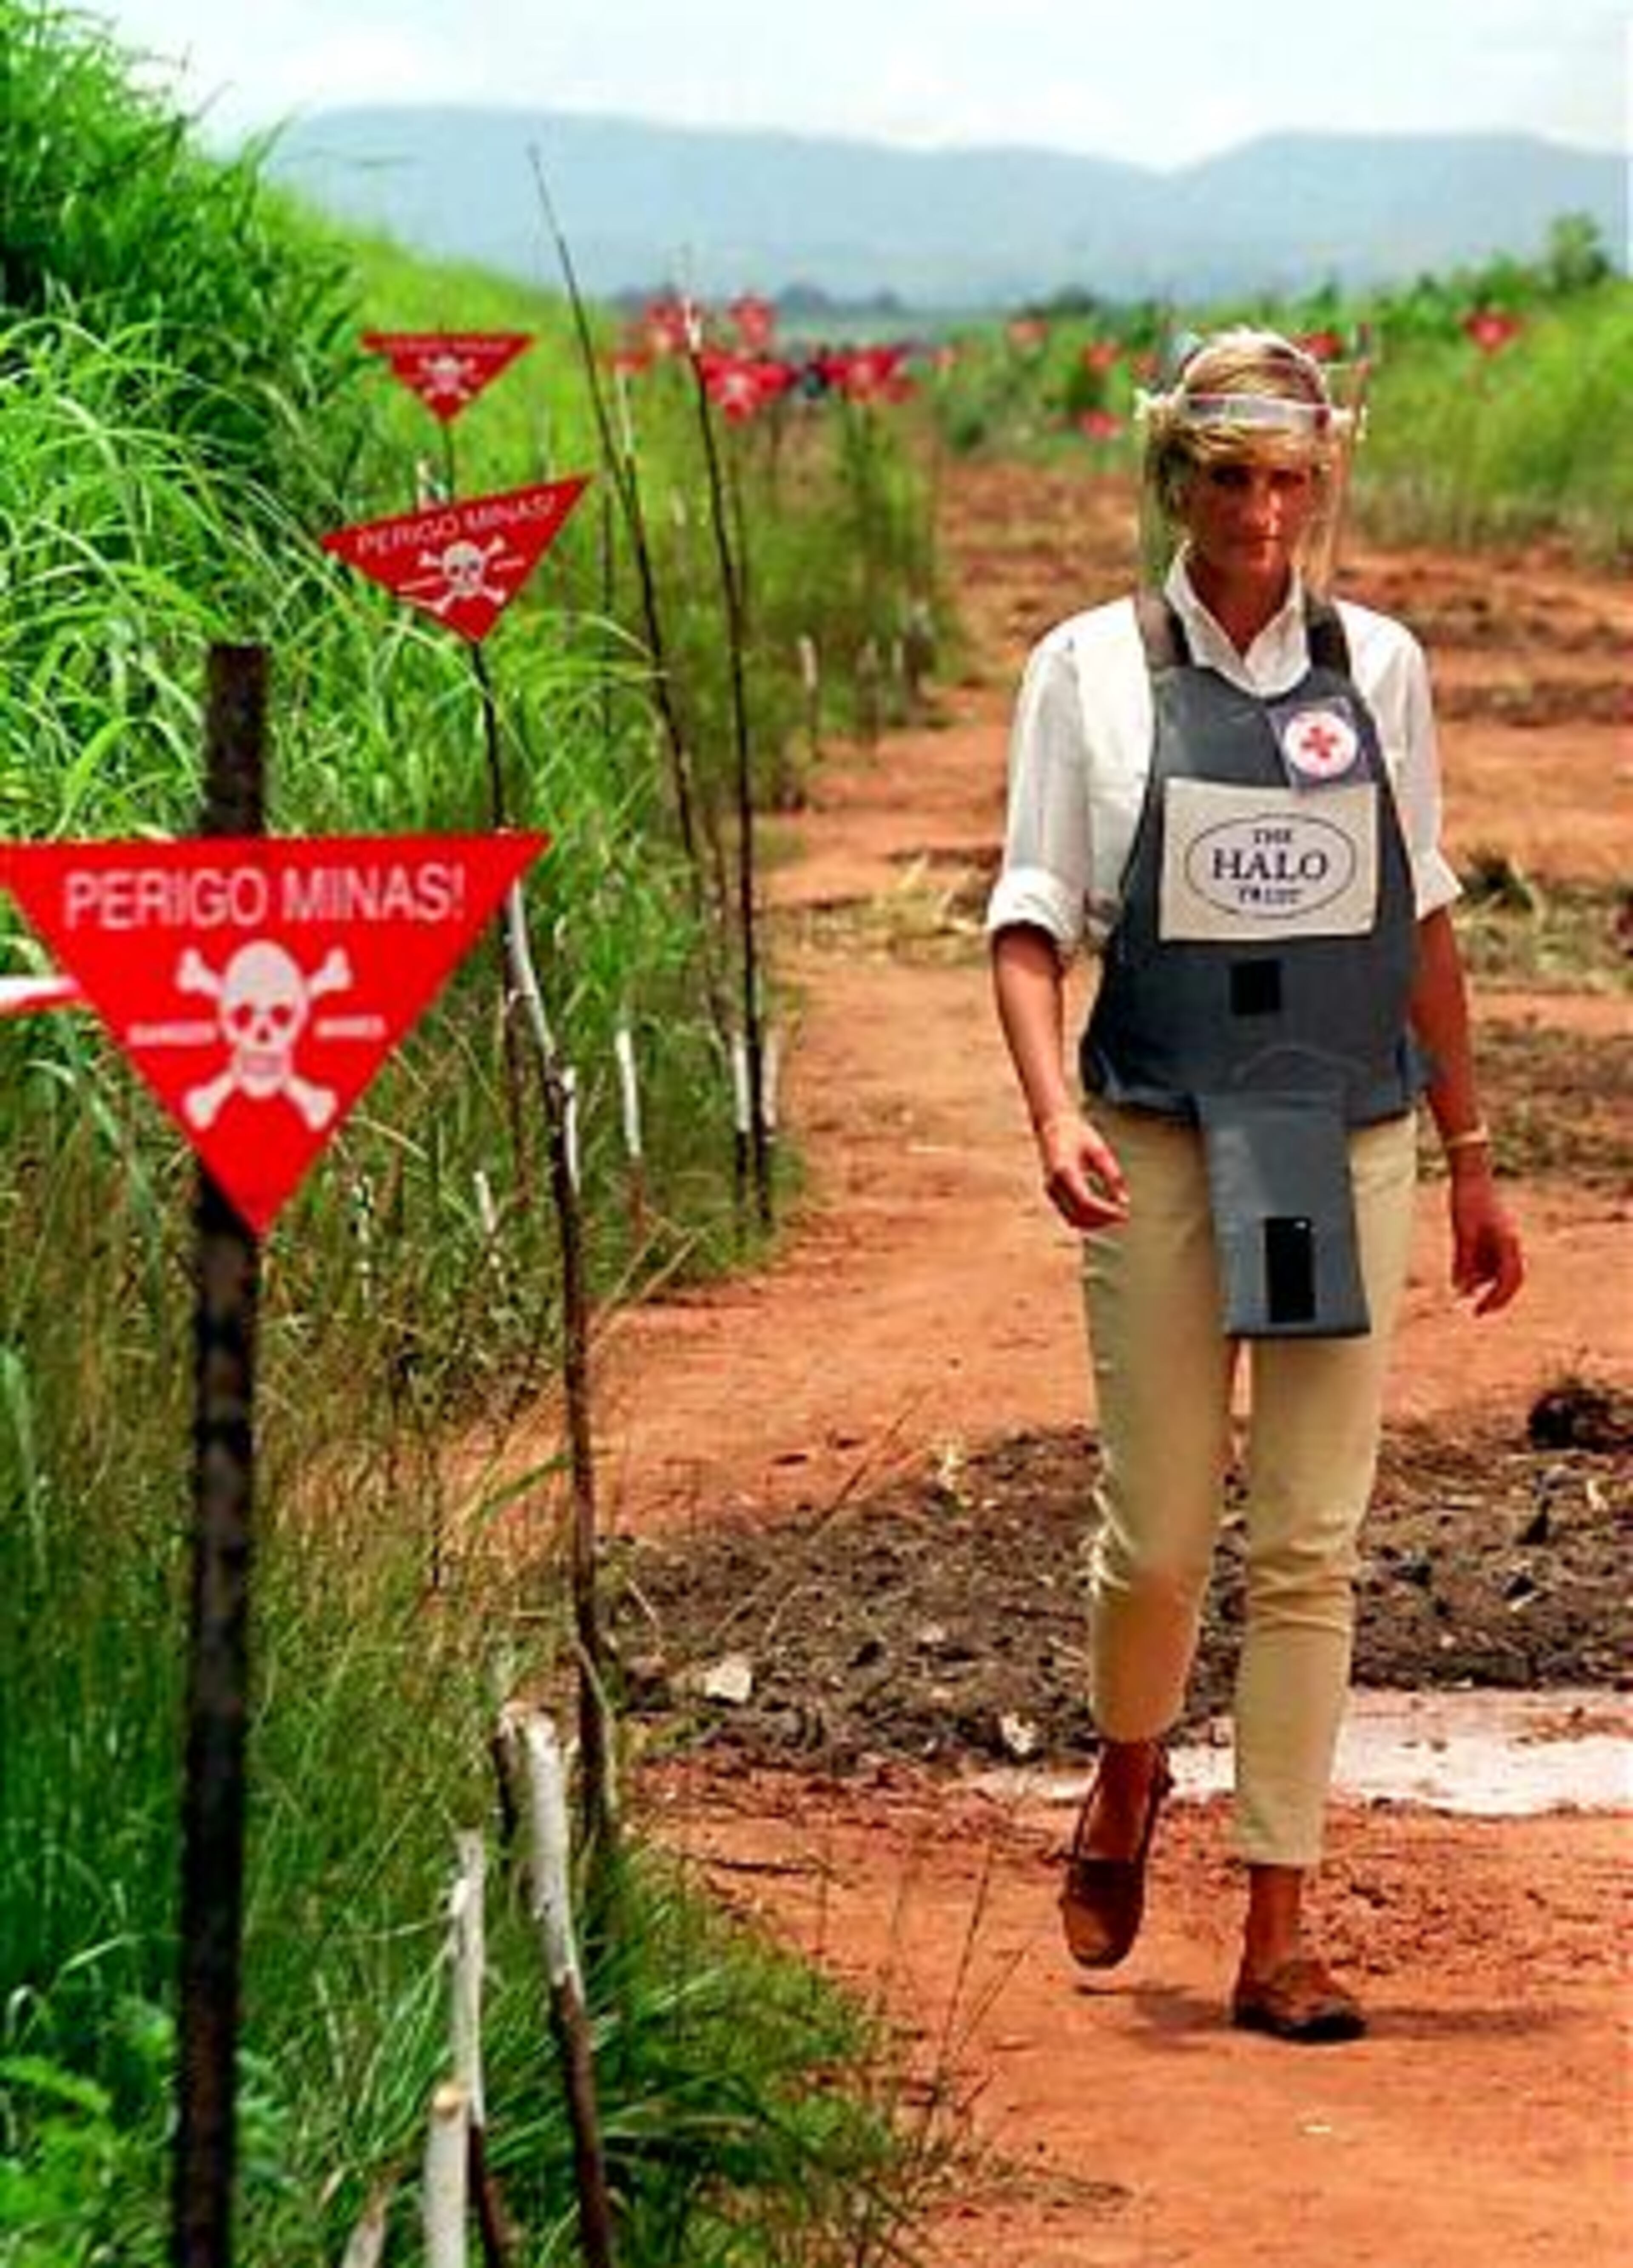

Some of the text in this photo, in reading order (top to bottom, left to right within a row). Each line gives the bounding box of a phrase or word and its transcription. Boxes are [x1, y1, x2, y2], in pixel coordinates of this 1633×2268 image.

[1253, 828, 1292, 844] THE
[1213, 849, 1327, 879] HALO
[65, 862, 465, 930] PERIGO MINAS!
